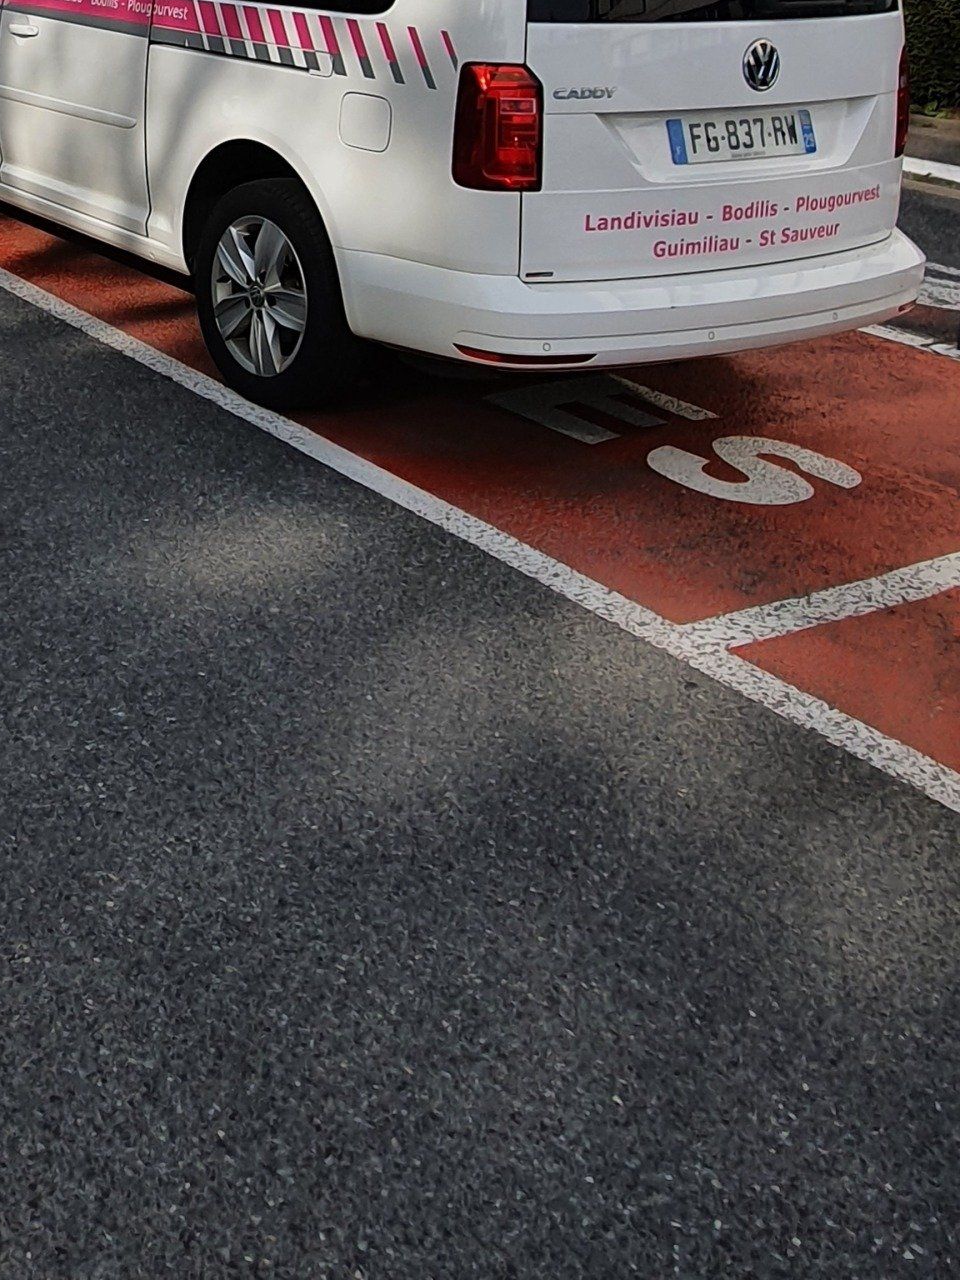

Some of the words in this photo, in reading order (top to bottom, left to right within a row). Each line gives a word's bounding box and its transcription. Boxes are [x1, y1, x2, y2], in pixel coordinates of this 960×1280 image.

[553, 86, 617, 99] CADDY
[585, 208, 699, 231] Landivisiau
[722, 200, 778, 222] Bodilis
[796, 184, 880, 212] Plougourvest
[653, 236, 739, 258] Guimiliau
[759, 230, 775, 247] St
[781, 221, 840, 245] Sauveur
